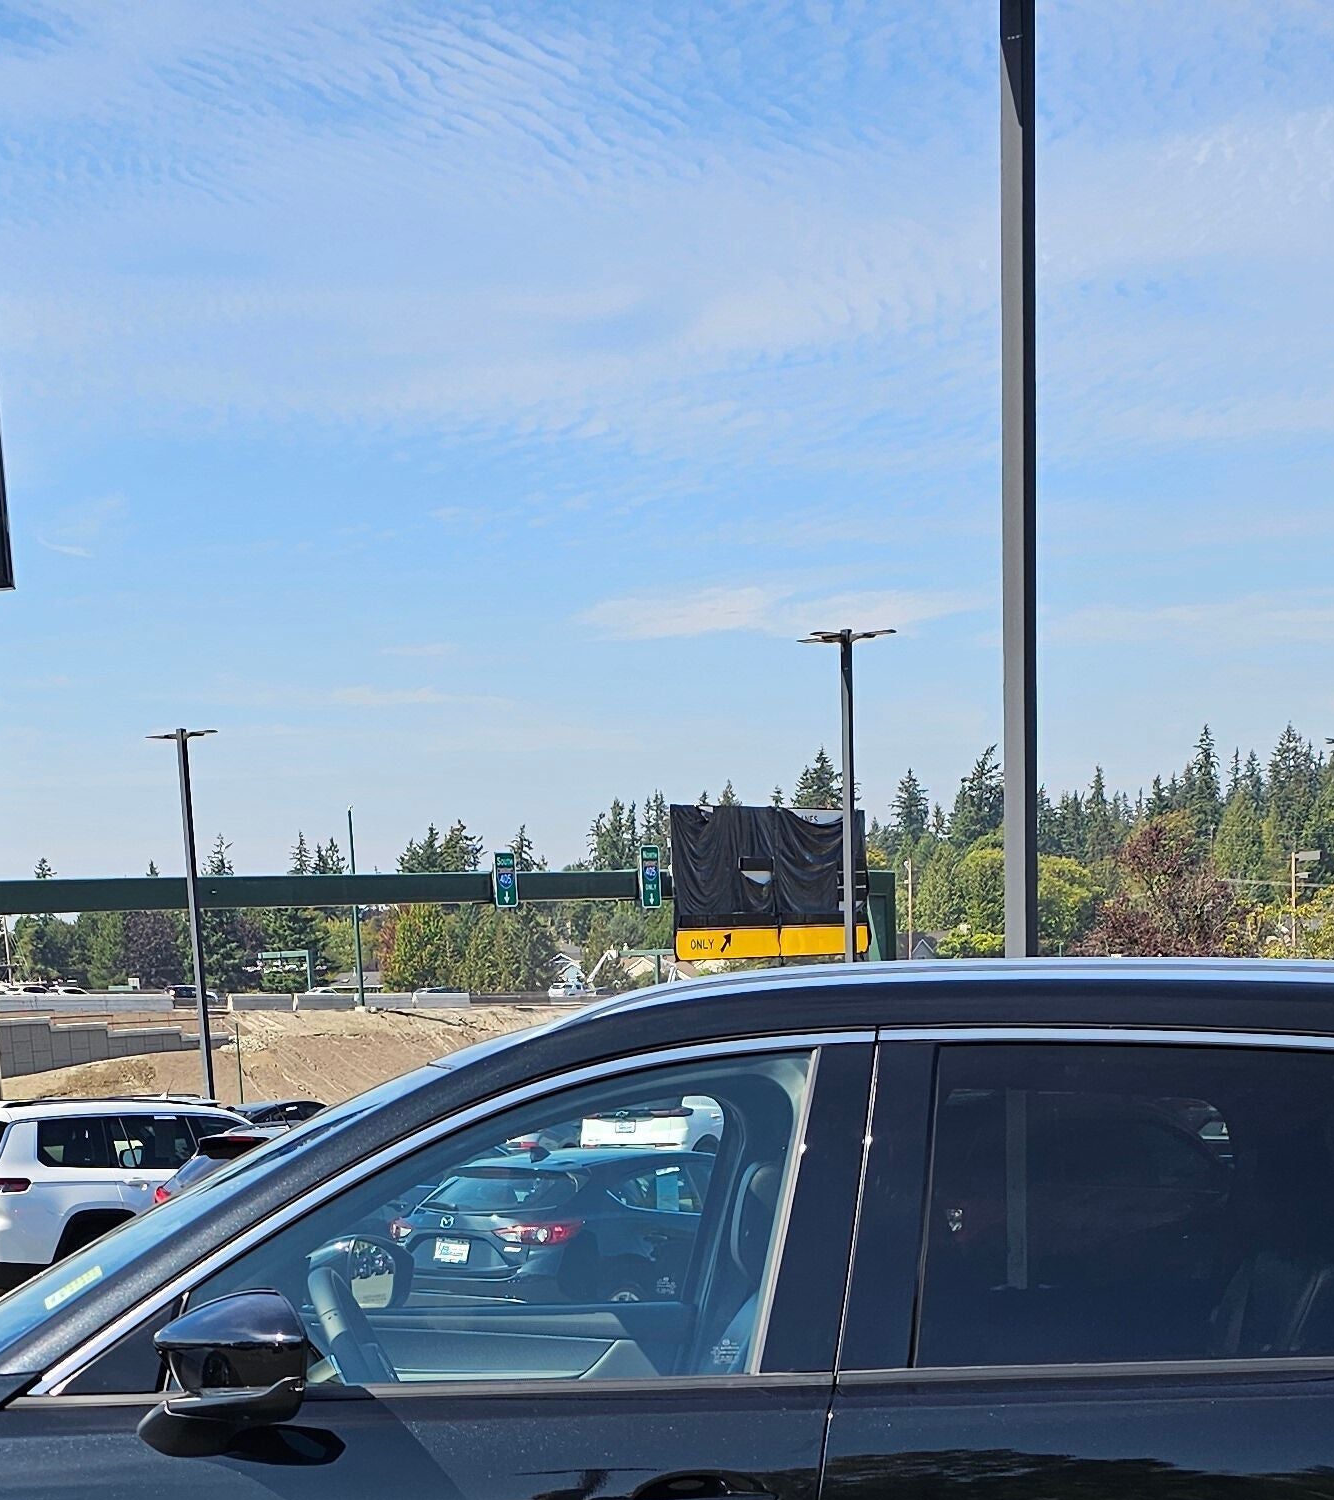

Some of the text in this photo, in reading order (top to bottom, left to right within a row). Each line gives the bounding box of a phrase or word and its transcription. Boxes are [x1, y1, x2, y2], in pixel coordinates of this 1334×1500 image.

[645, 866, 657, 877] 405
[499, 873, 512, 884] 405
[690, 938, 715, 950] ONLY
